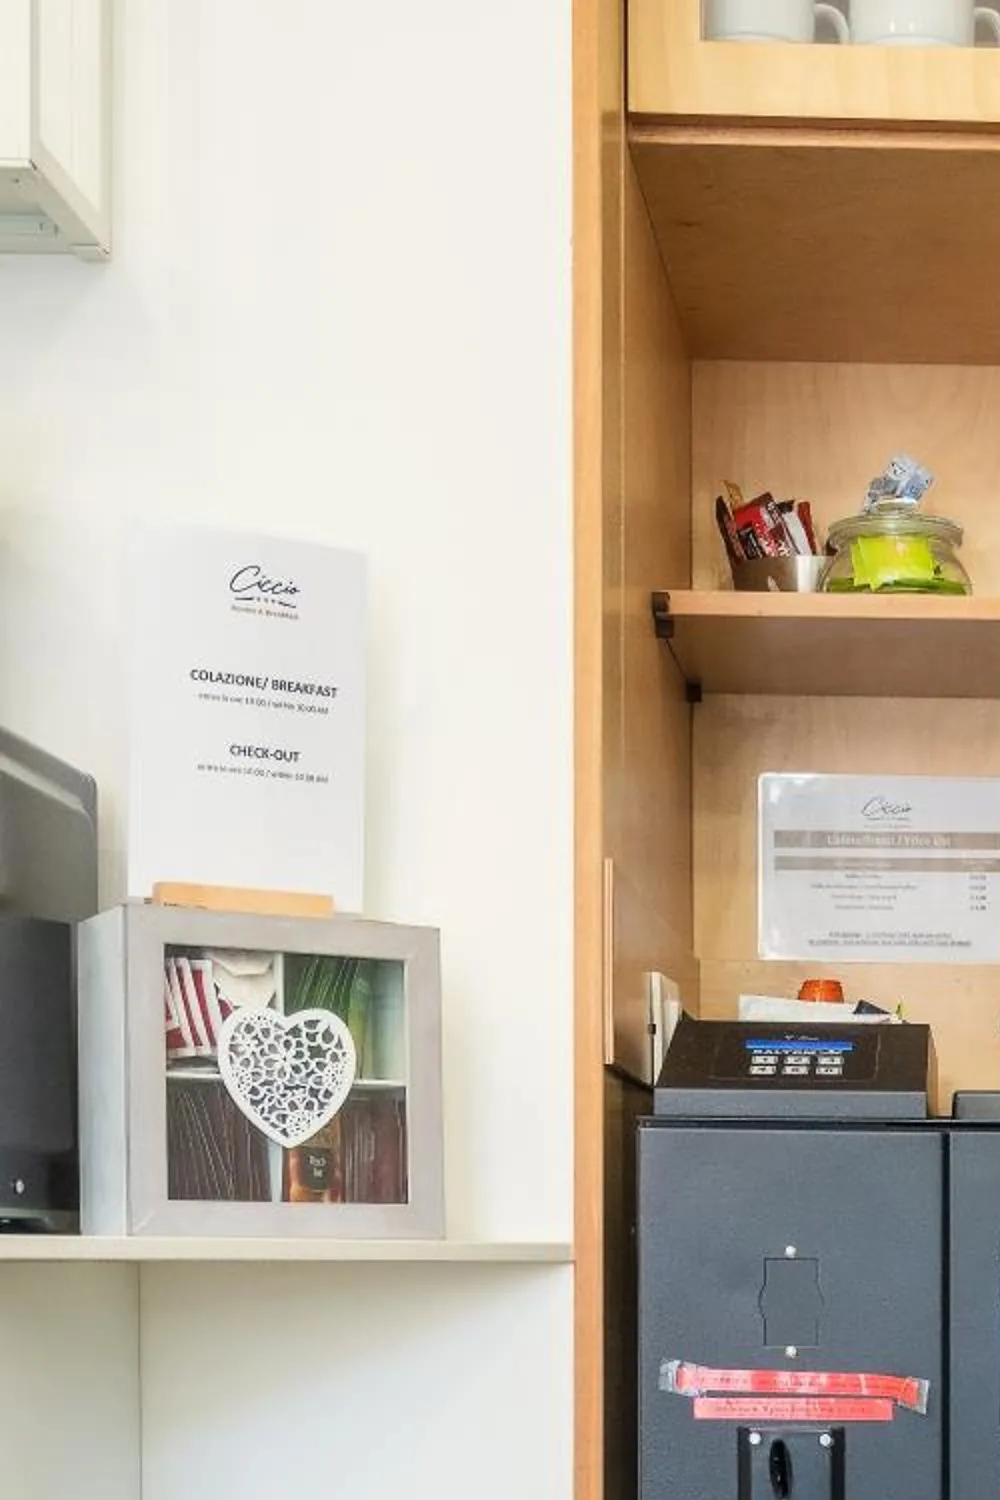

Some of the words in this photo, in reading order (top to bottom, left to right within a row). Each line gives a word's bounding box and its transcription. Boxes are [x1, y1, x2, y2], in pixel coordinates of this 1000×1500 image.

[229, 565, 301, 594] Ciccio
[190, 669, 269, 690] COLAZIONE/
[272, 679, 338, 698] BREAKFAST
[229, 744, 300, 763] CHECK-OUT
